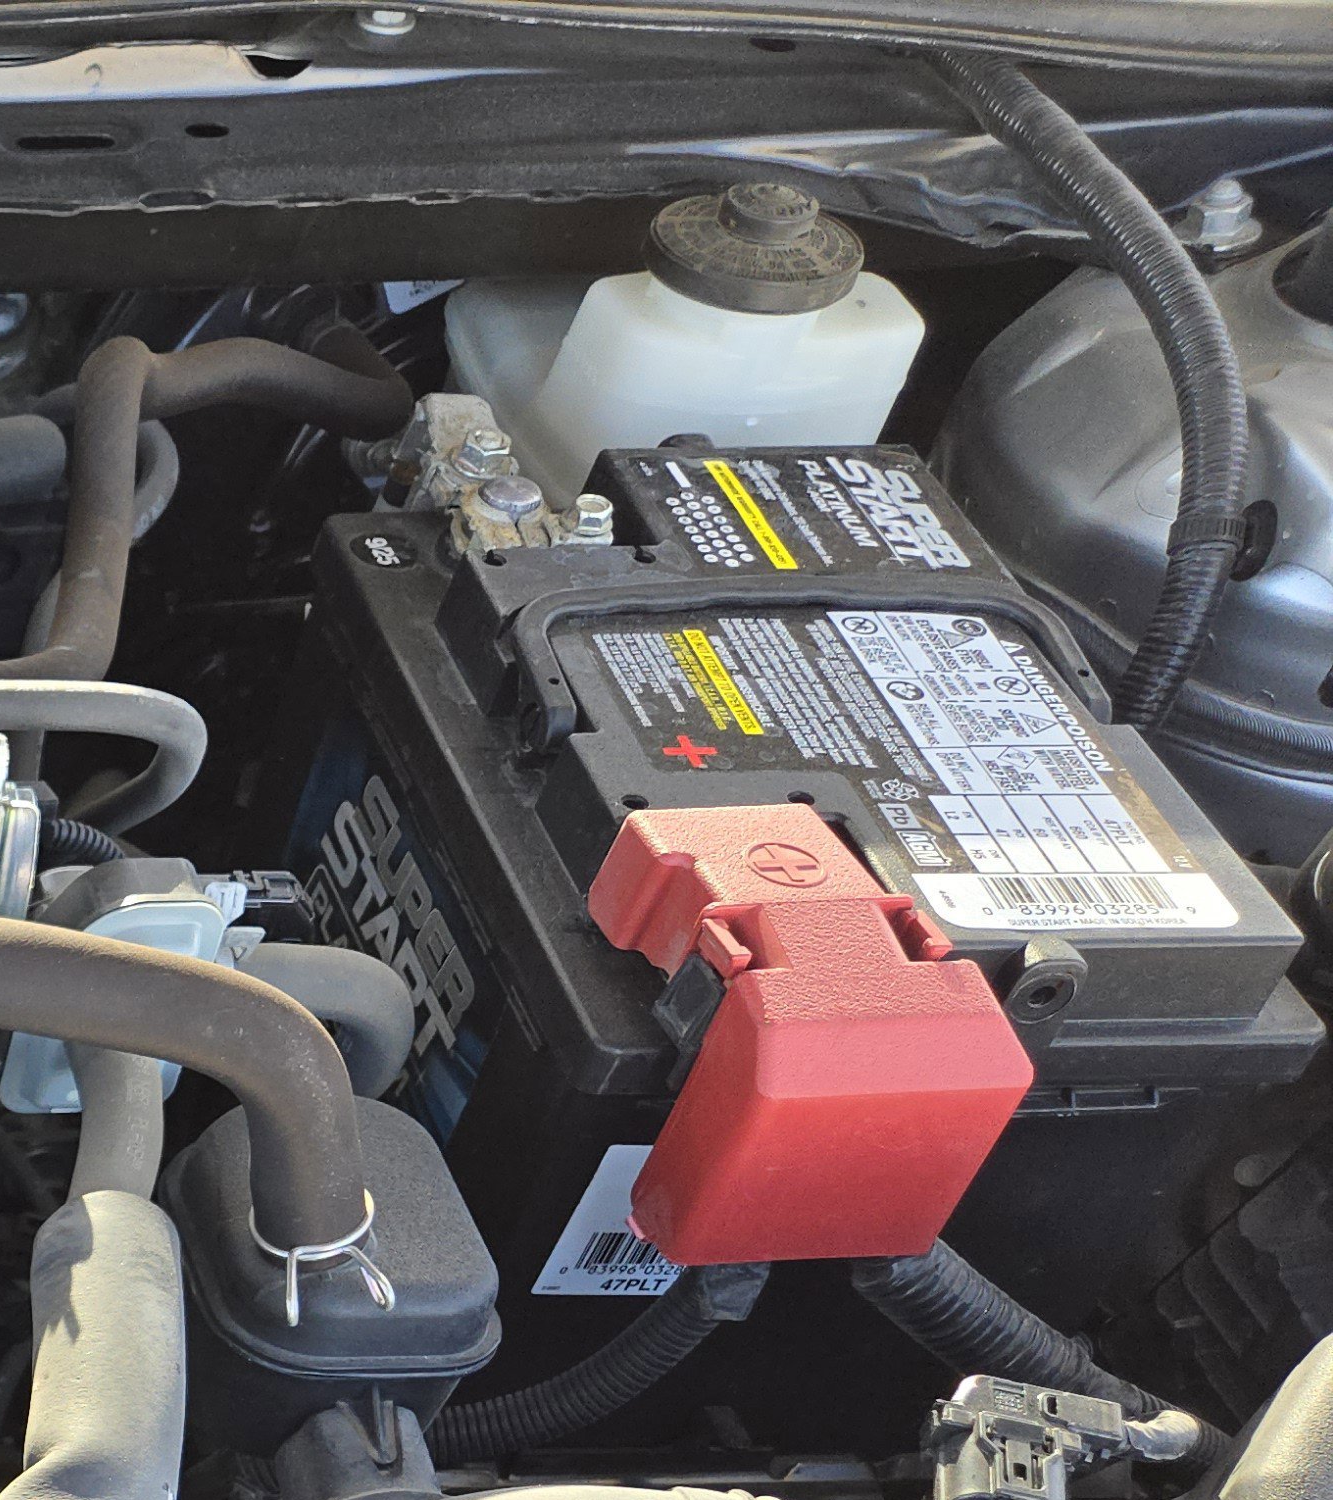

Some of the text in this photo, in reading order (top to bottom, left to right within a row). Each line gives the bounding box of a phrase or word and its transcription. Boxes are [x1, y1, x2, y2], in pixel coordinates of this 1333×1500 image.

[797, 458, 880, 548] PLATINUM
[825, 455, 941, 570] START
[884, 469, 972, 569] SUPER
[364, 536, 401, 566] 9/25
[1010, 654, 1116, 771] DANGER/POISON
[885, 807, 911, 825] Pb
[992, 828, 1011, 838] 47
[1100, 819, 1135, 845] 47PLT
[900, 832, 947, 865] AGM
[362, 774, 475, 1030] SUPER
[1020, 904, 1085, 916] 83996
[1094, 904, 1161, 916] 03285
[320, 800, 457, 1057] START
[587, 1264, 637, 1276] 83996
[599, 1278, 668, 1292] 47PLT
